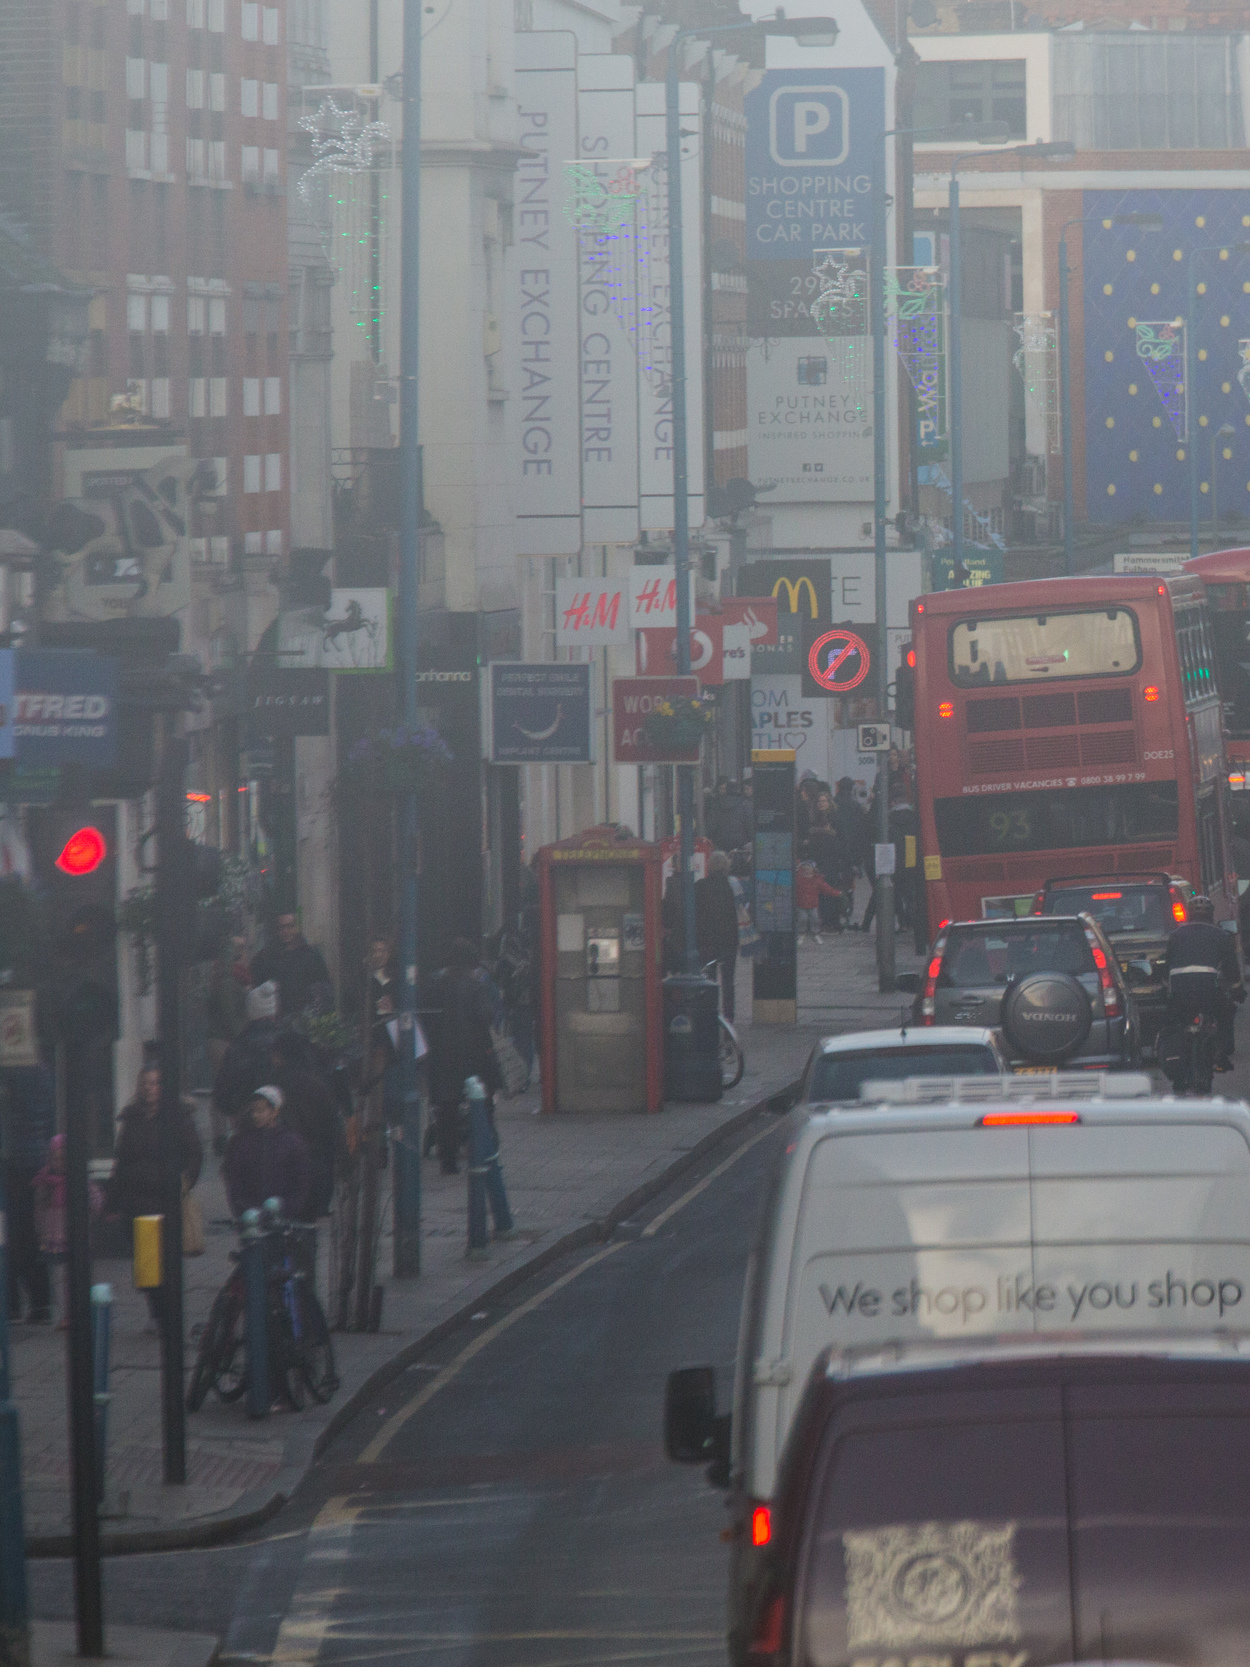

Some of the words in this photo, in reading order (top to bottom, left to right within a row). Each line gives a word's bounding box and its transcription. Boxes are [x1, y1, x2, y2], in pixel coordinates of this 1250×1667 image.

[793, 101, 831, 153] P
[519, 111, 550, 251] PUTNEY
[748, 174, 872, 196] SHOPPING
[766, 198, 855, 219] CENTRE
[756, 223, 802, 243] CAR
[811, 222, 866, 241] PARK
[520, 269, 554, 476] EXCHANGE
[582, 332, 613, 463] CENTRE
[775, 395, 850, 409] PUTNEY
[757, 410, 869, 425] EXCHANGE
[812, 430, 868, 440] SHOPPIN
[562, 591, 622, 632] H&M
[62, 724, 109, 738] KING
[962, 784, 980, 794] BUS
[981, 781, 1013, 793] DRIVER
[1014, 778, 1063, 791] VACANCIES
[1080, 775, 1102, 785] 0800
[1103, 775, 1114, 784] 38
[1116, 774, 1127, 783] 99
[1134, 772, 1146, 781] 99
[989, 811, 1031, 839] 93
[817, 1278, 881, 1318] We
[891, 1277, 987, 1324] shop
[997, 1273, 1057, 1314] like
[1065, 1280, 1138, 1323] you
[1146, 1268, 1243, 1318] shop
